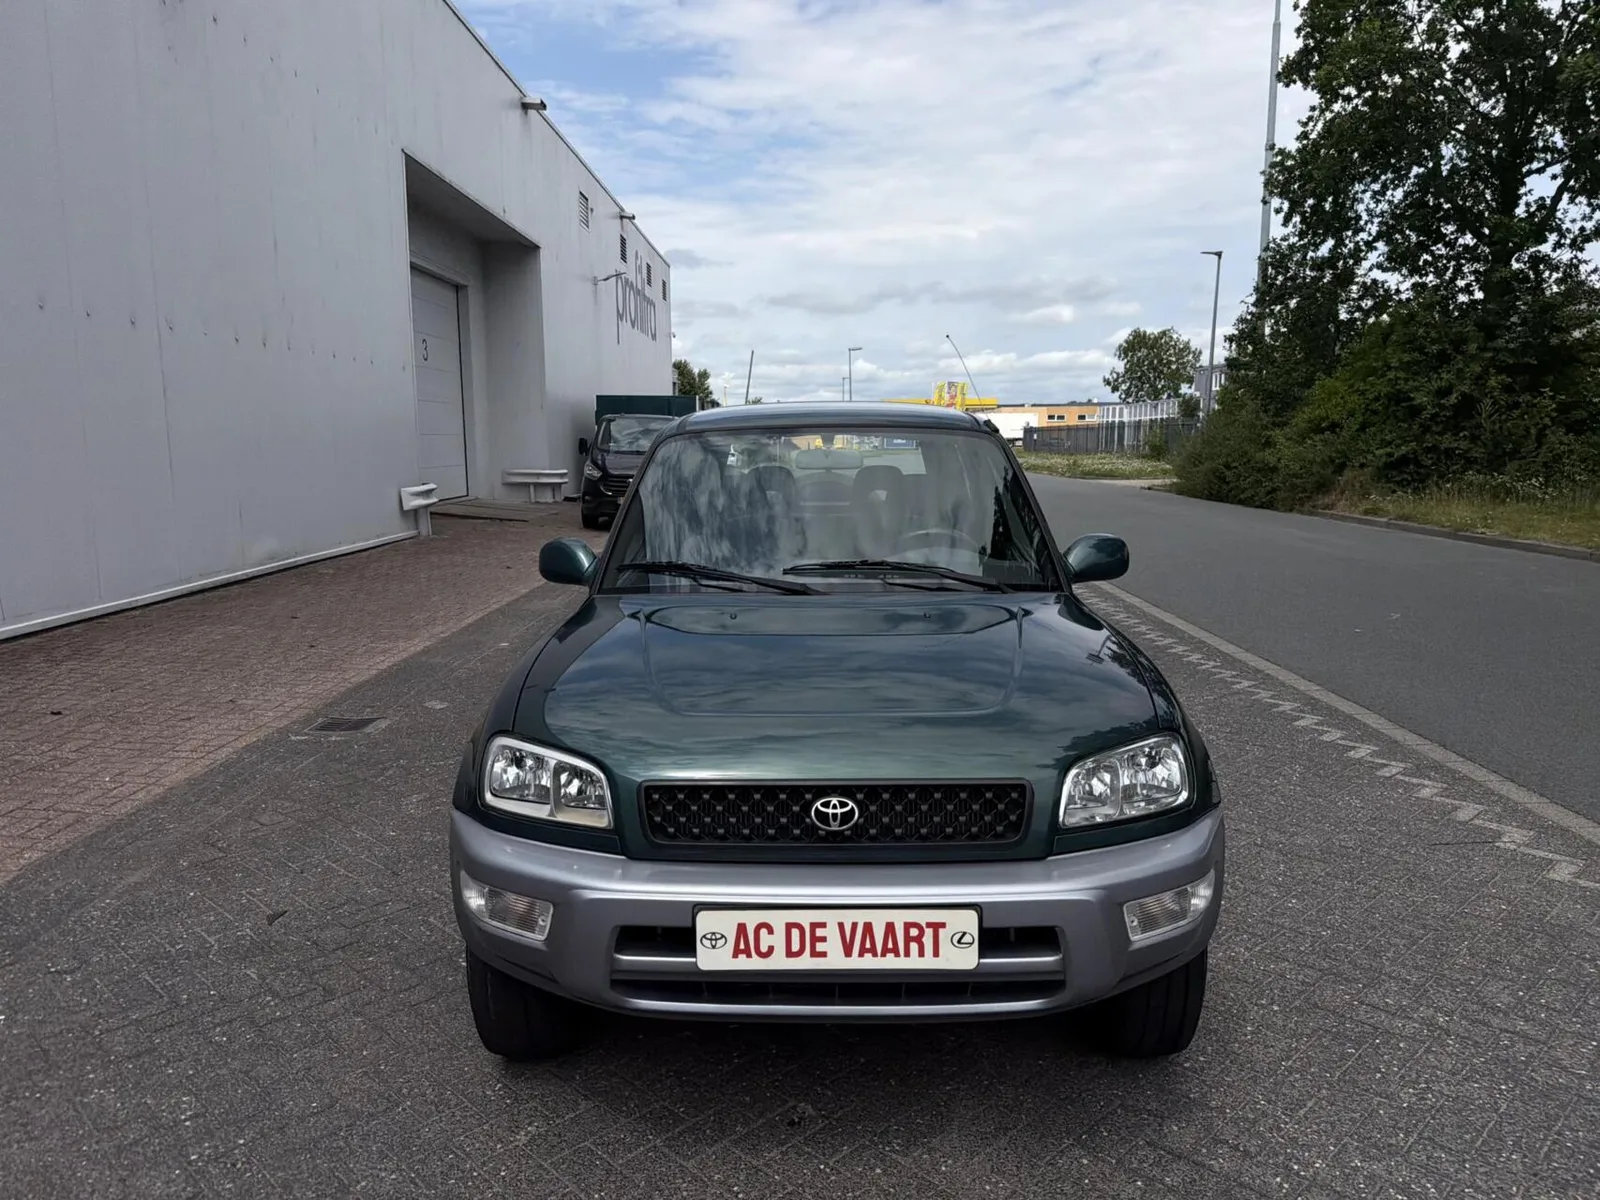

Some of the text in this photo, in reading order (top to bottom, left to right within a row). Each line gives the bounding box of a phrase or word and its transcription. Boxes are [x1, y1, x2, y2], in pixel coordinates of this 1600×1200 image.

[421, 338, 429, 362] 3
[731, 921, 947, 959] AC DE VAART
